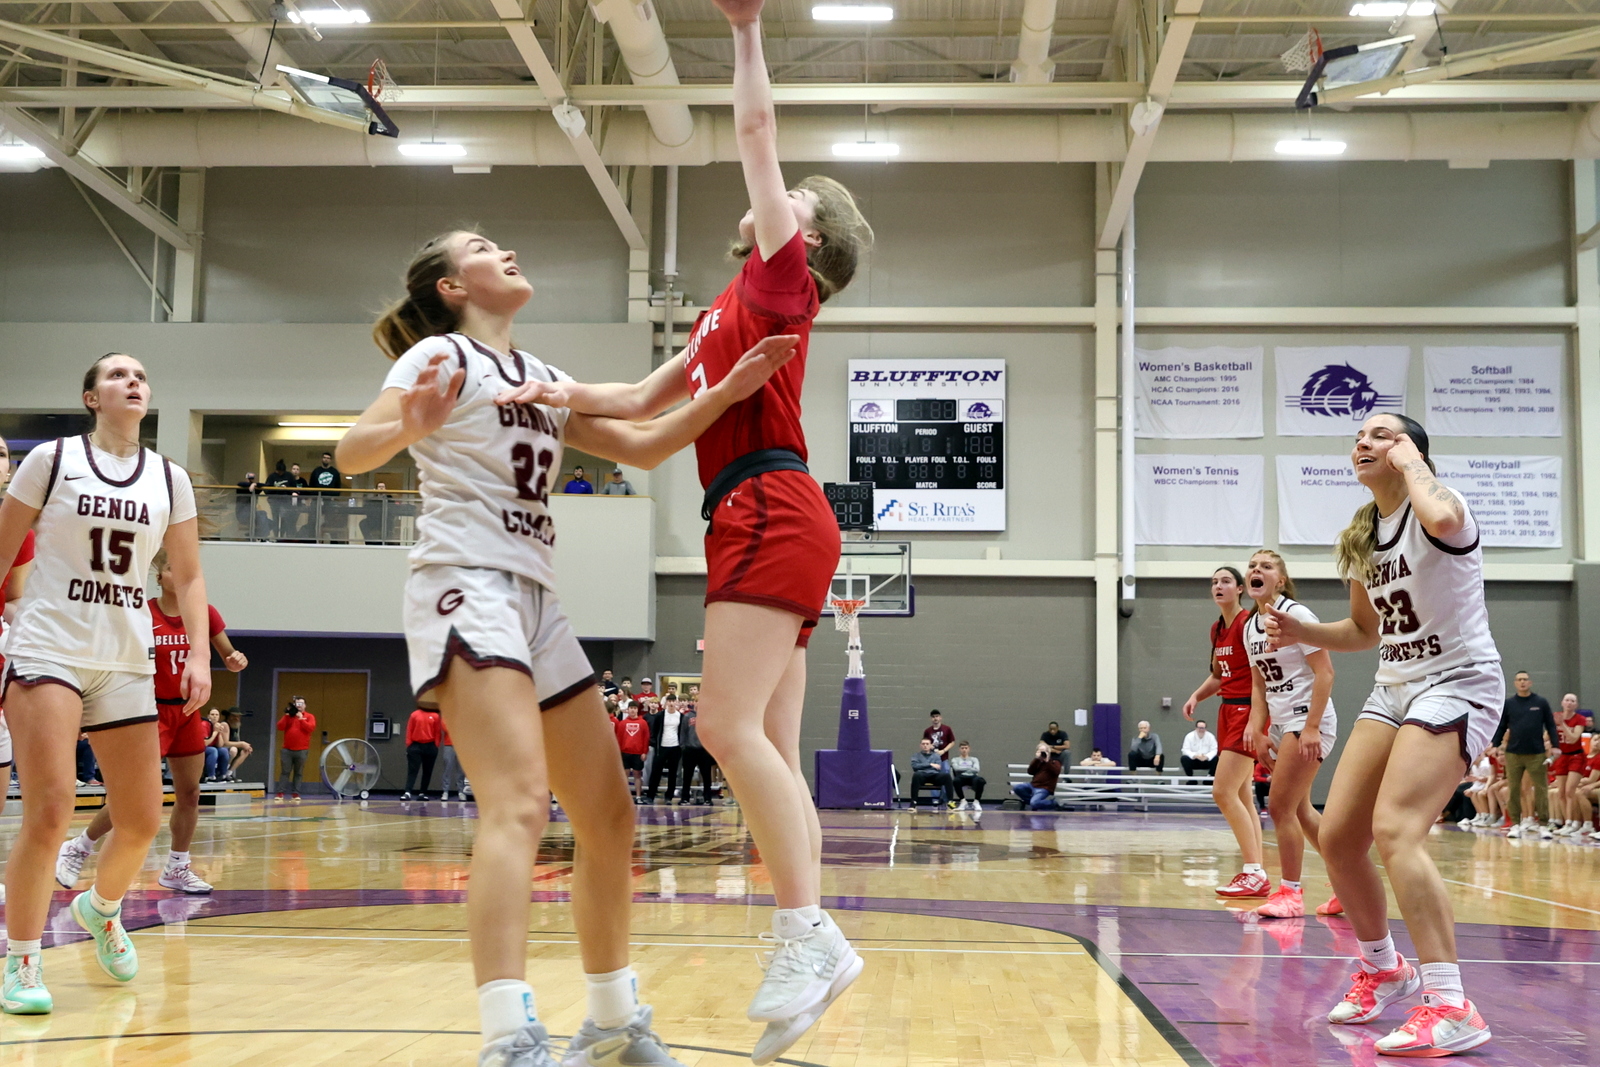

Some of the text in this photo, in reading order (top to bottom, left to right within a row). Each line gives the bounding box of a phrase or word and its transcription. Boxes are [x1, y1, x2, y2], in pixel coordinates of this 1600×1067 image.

[1139, 362, 1252, 372] Women's Basketball
[1471, 366, 1512, 375] Softball
[851, 371, 1002, 382] BLUFFTON
[1173, 375, 1217, 383] Champions:
[1175, 386, 1218, 394] Champions:
[853, 424, 898, 433] BLUFFTON
[964, 423, 993, 433] GUEST
[1468, 460, 1520, 470] Volleyball
[511, 442, 553, 508] 22
[1153, 466, 1239, 476] Women's Tennis
[1301, 467, 1353, 476] Women's
[1325, 479, 1363, 487] Champion
[77, 494, 150, 526] GENOA
[89, 527, 136, 576] 15
[68, 579, 144, 610] COMETS
[1374, 588, 1421, 634] 23
[1380, 634, 1442, 662] OMETS
[1255, 658, 1284, 682] 25
